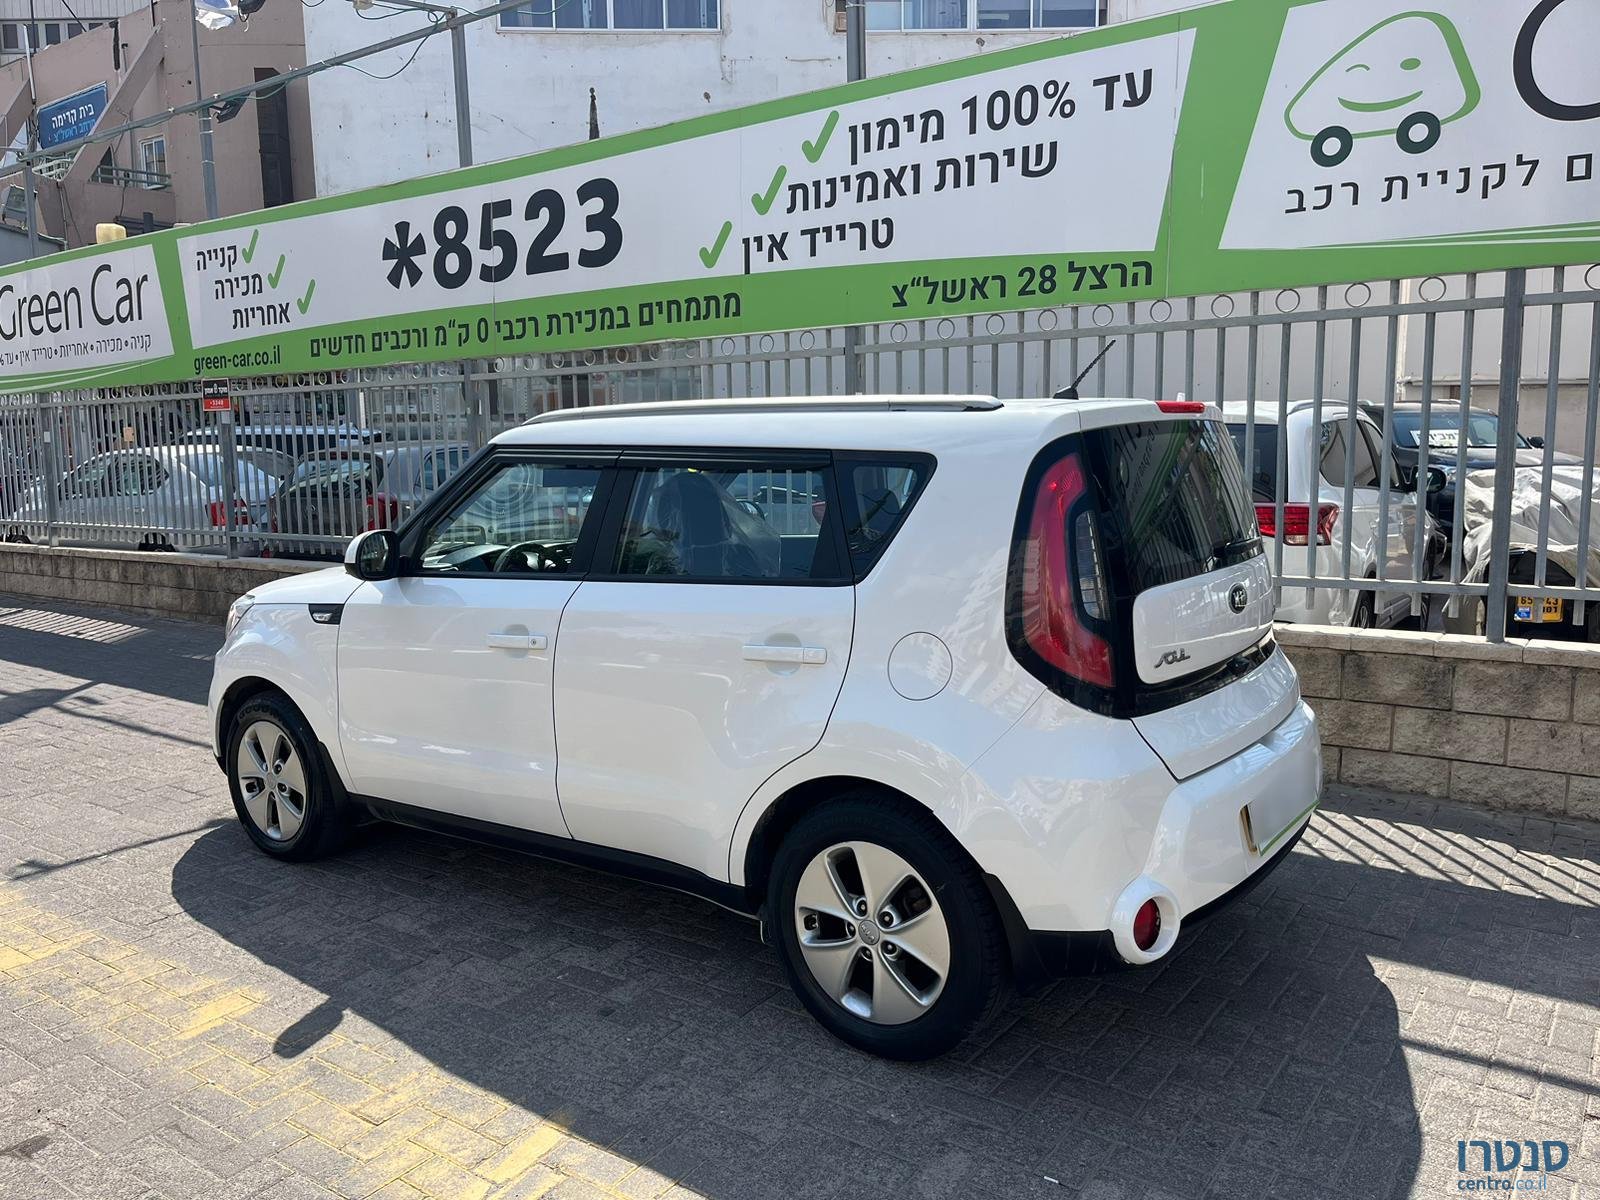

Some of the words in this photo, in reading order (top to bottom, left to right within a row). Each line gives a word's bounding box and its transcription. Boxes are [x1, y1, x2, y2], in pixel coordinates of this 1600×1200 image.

[1092, 68, 1153, 112] עד
[79, 104, 95, 120] בית
[961, 79, 1076, 135] 100%
[848, 108, 945, 166] מימון
[934, 140, 1058, 193] שירות
[1380, 153, 1540, 203] לקניית
[786, 162, 921, 215] ואמינות
[1284, 182, 1359, 214] רכב
[741, 231, 789, 275] אין
[800, 216, 894, 258] טרייד
[196, 245, 238, 273] קנייה
[214, 273, 263, 300] מכירה
[1017, 264, 1057, 297] 28
[1067, 260, 1153, 292] הרצל
[0, 284, 83, 341] Green
[90, 263, 149, 326] Car
[232, 302, 291, 330] אחריות
[638, 292, 741, 327] מתמחים
[476, 317, 489, 344] 0
[495, 316, 540, 342] רכבי
[545, 305, 631, 337] במכירת
[32, 346, 53, 361] טרייד
[59, 342, 89, 359] אחריות
[96, 337, 123, 354] מכירה
[130, 334, 152, 353] קניה
[310, 334, 366, 358] חדשים
[371, 327, 428, 352] ורכבים
[194, 345, 281, 375] green-car.co.il
